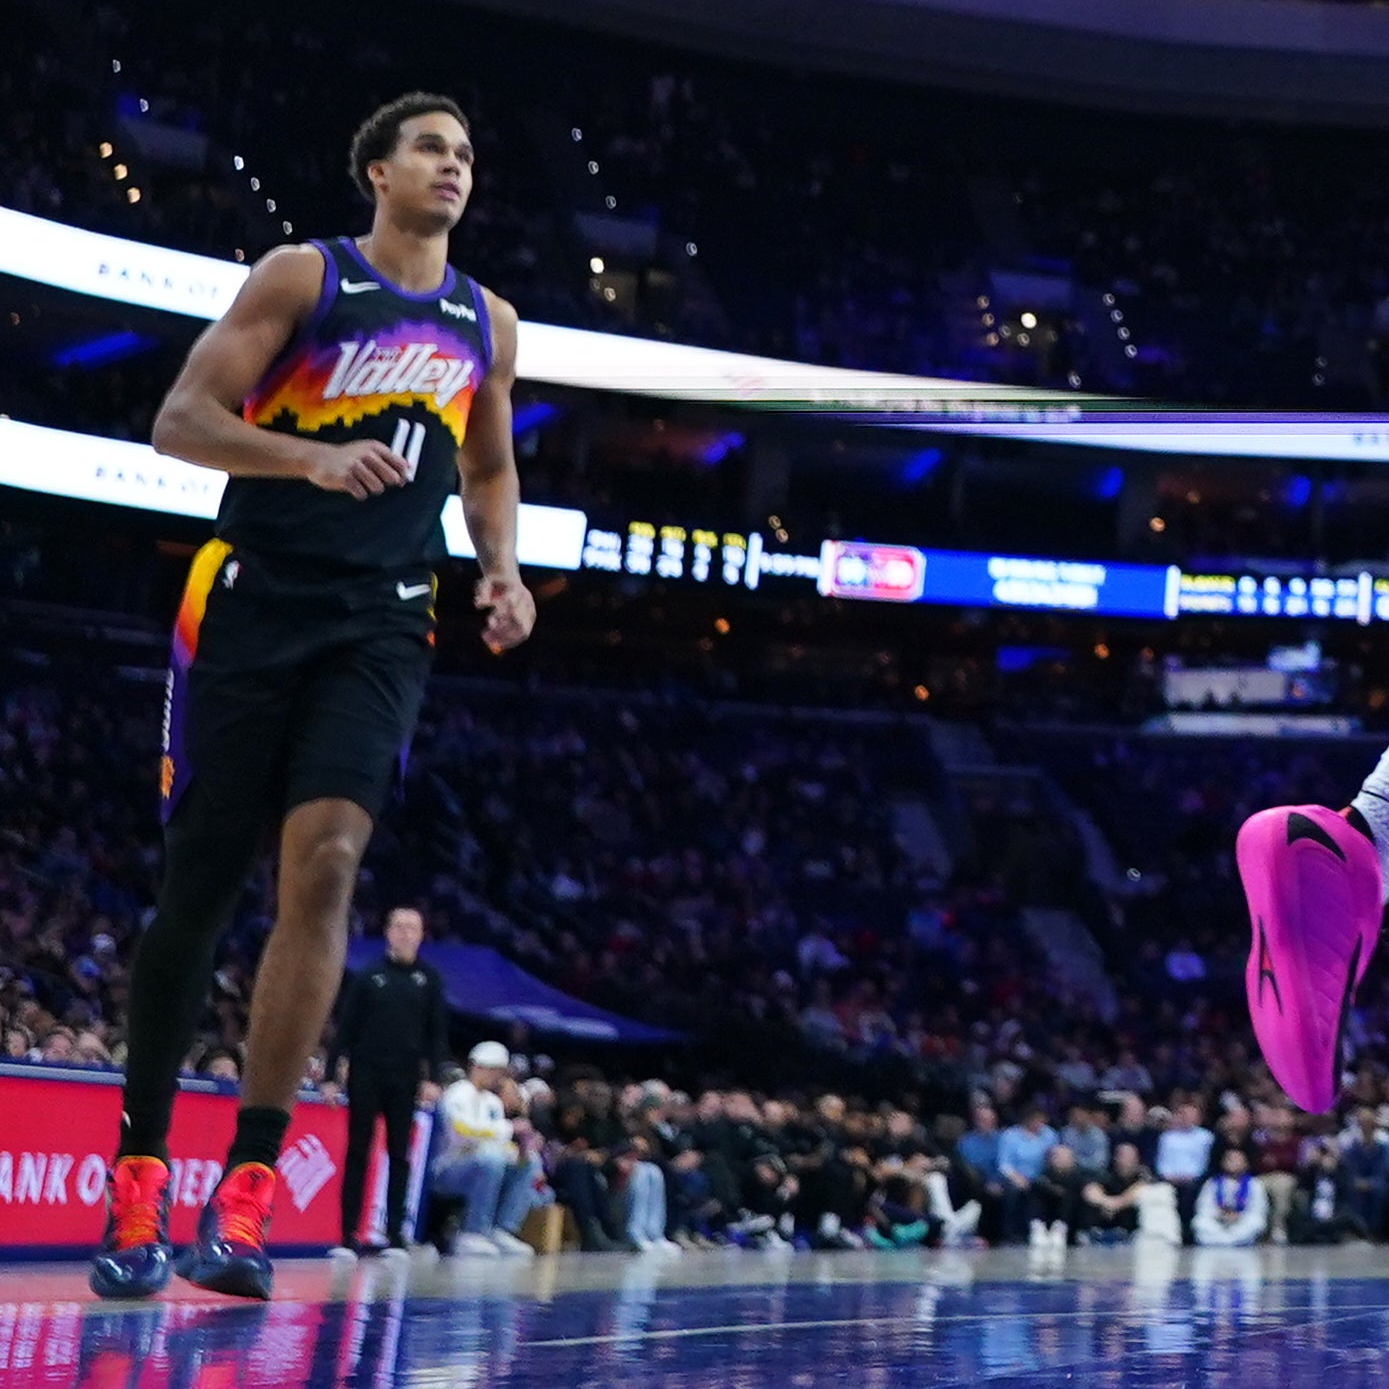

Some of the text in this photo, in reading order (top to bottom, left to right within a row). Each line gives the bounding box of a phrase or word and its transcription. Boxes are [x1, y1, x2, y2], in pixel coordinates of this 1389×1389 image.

[97, 261, 175, 293] BANK
[322, 340, 474, 409] Valley
[391, 418, 426, 482] 11
[94, 465, 167, 490] BANK
